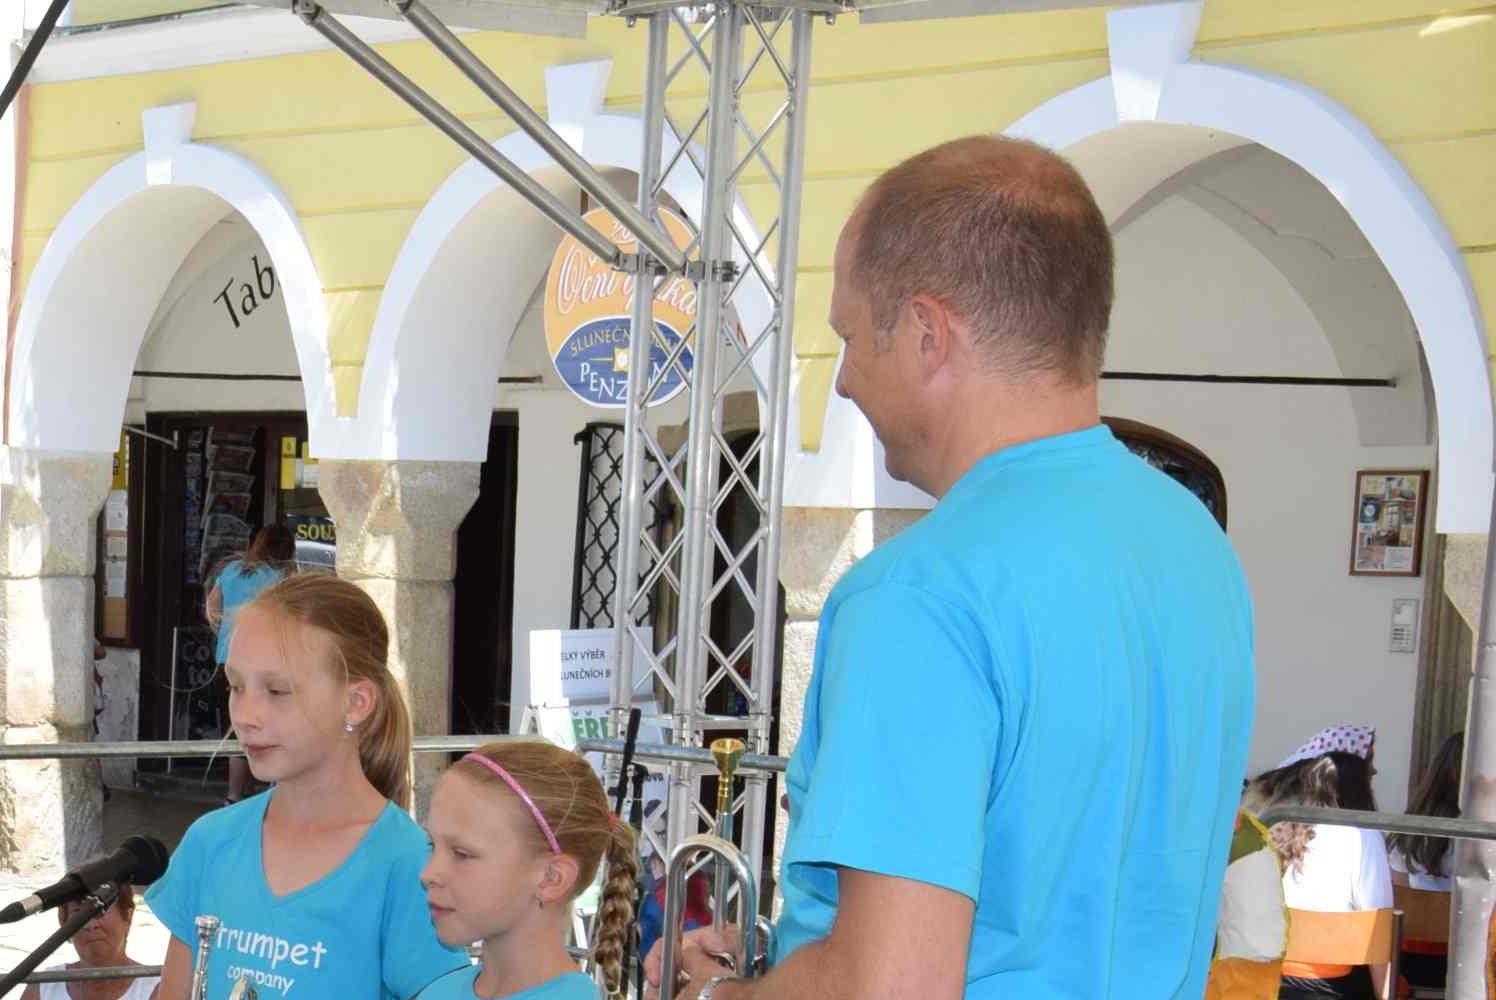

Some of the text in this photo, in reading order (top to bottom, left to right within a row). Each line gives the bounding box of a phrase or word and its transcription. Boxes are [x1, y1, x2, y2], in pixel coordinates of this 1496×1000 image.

[213, 256, 276, 328] Tab
[569, 325, 632, 357] SLUNEČN
[579, 362, 670, 401] PENZN
[560, 667, 603, 681] LUNEČNÍCH
[216, 920, 328, 970] trumpet
[226, 964, 296, 998] company
